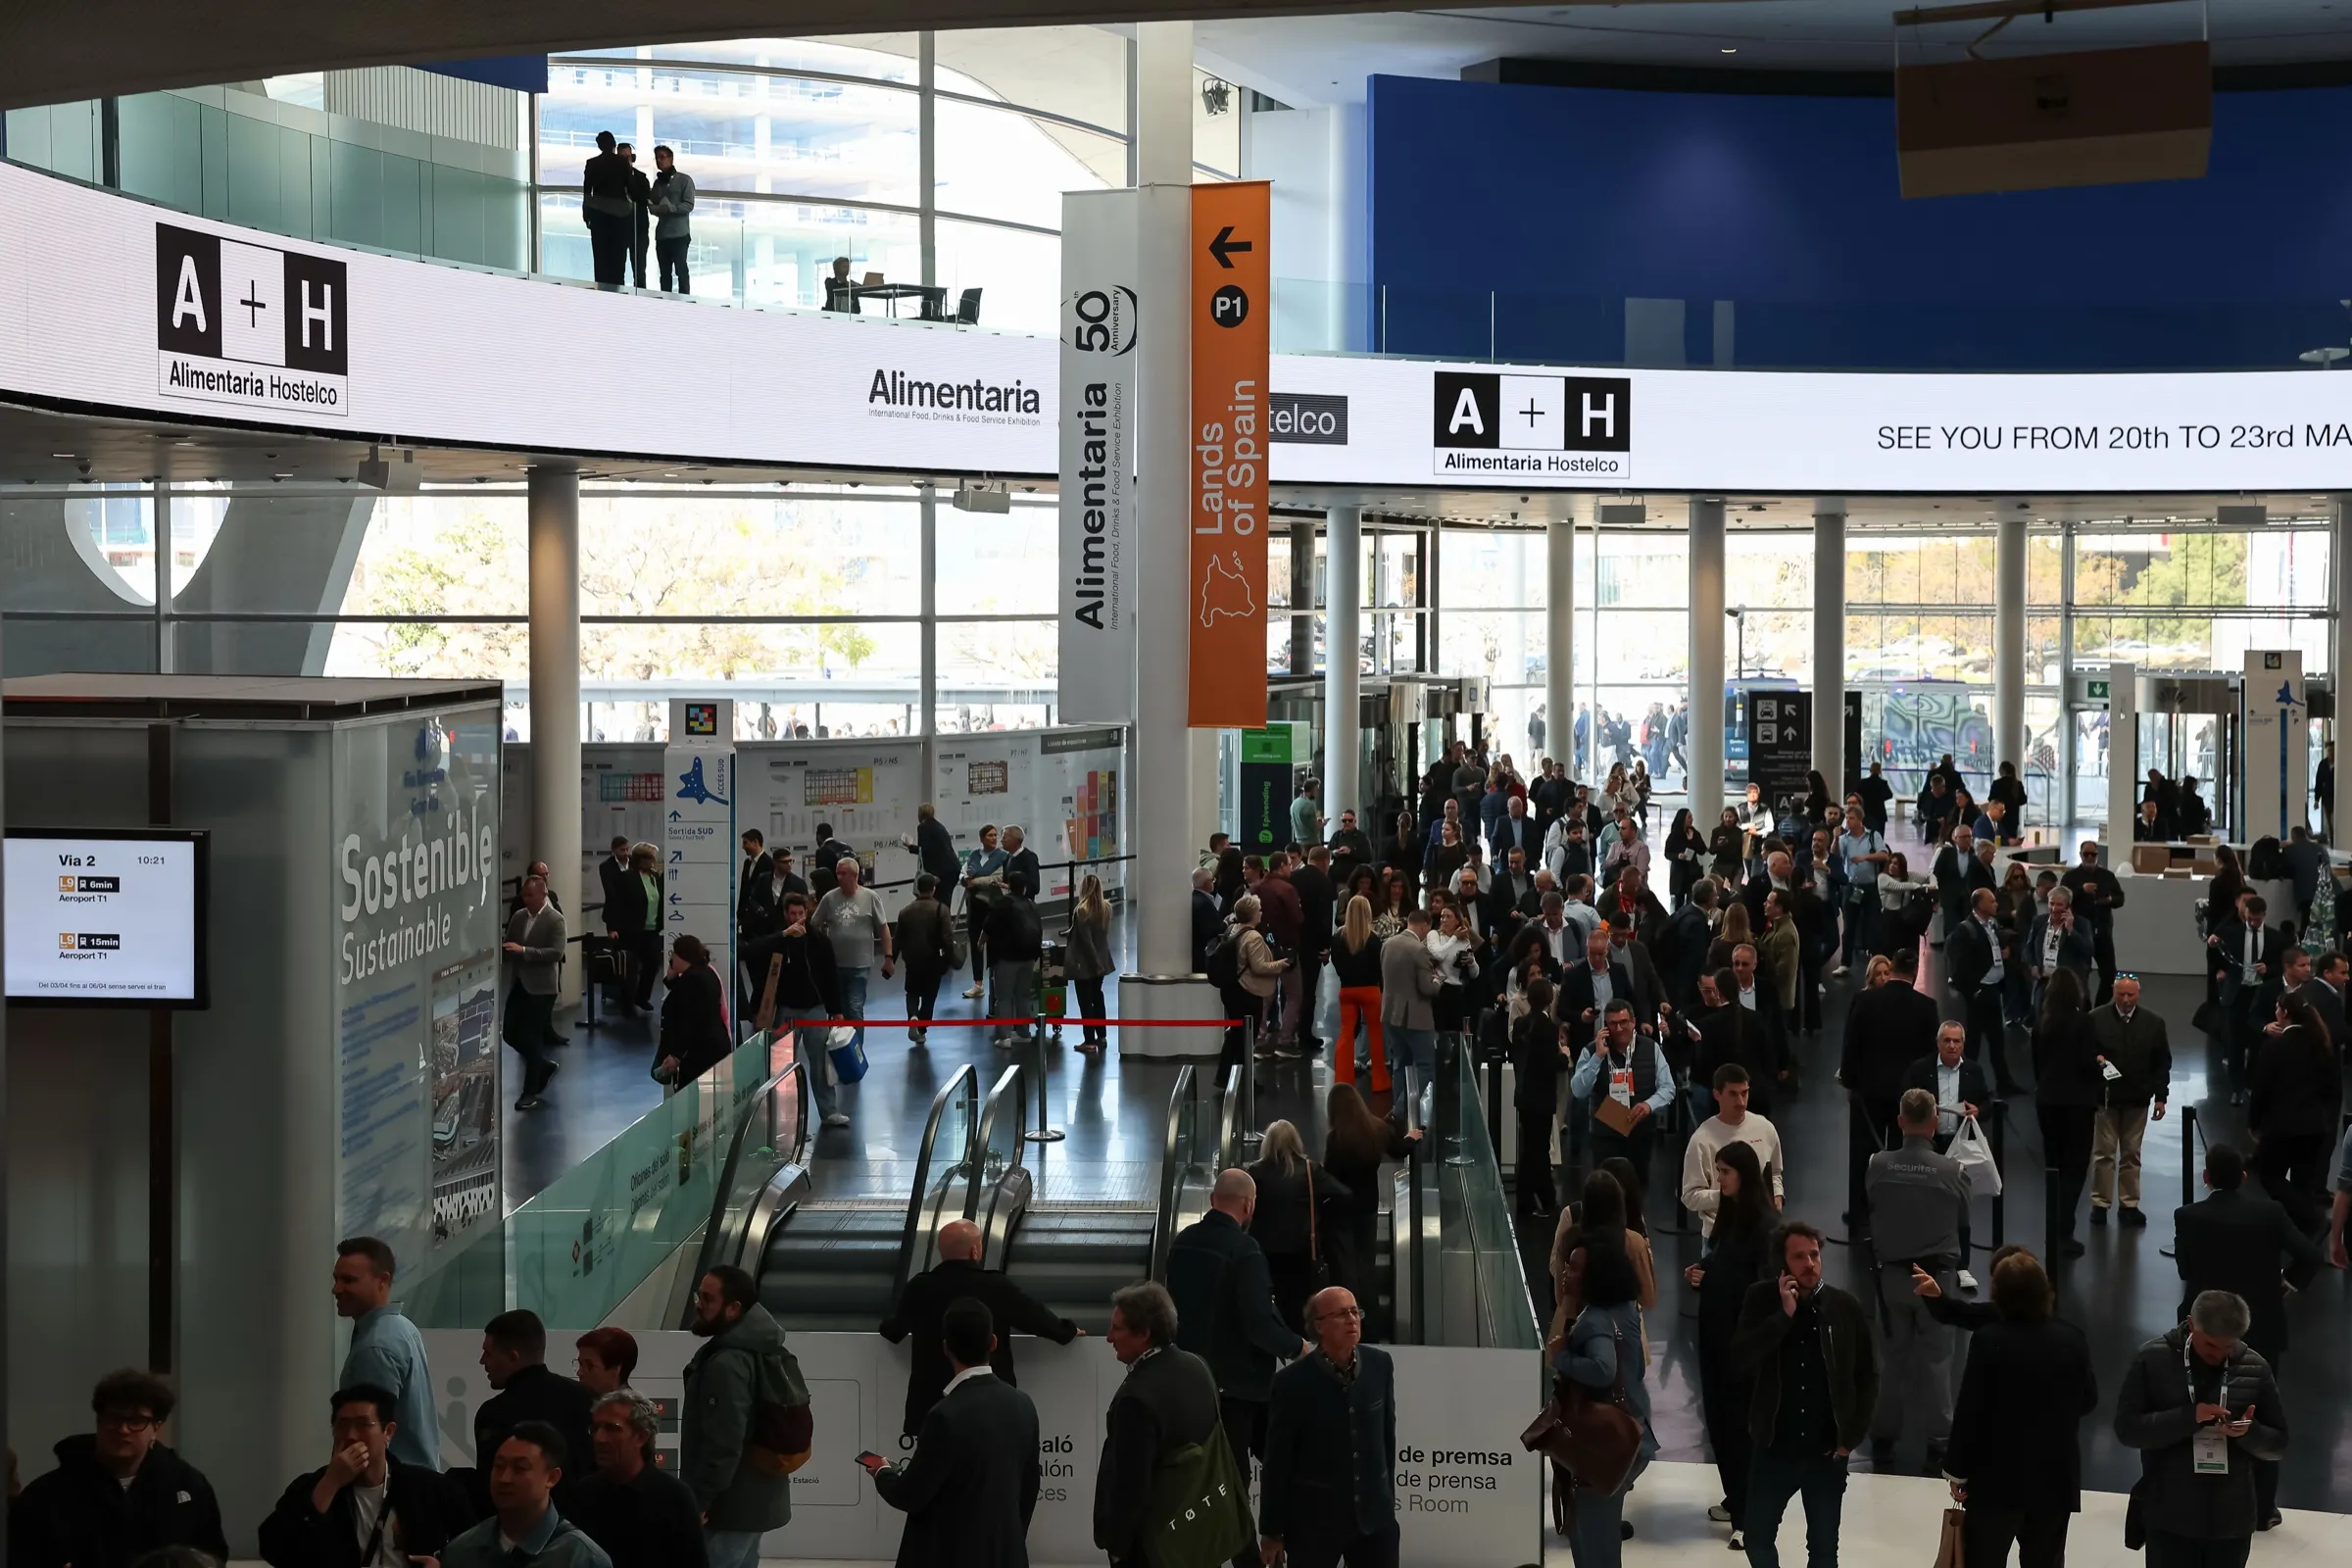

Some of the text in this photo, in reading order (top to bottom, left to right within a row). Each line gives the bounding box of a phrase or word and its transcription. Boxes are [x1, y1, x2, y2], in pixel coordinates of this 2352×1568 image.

[172, 255, 207, 333] A
[302, 279, 332, 351] H
[1216, 297, 1242, 318] P1
[1111, 289, 1121, 351] Anniversary
[170, 361, 337, 406] Alimentaria Hostelco
[868, 368, 1040, 415] Alimentaria
[868, 408, 1041, 426] International Food, Drinks & Food Service Exhibition
[1112, 382, 1122, 430] Exhibition
[1269, 403, 1336, 435] telco
[1448, 387, 1484, 435] A
[1582, 392, 1614, 438] H
[1112, 431, 1121, 468] Service
[1878, 425, 1932, 450] SEE
[1940, 425, 2002, 450] YOU
[2013, 425, 2098, 450] FROM
[2108, 425, 2169, 450] 20th
[2179, 424, 2221, 450] TO
[2230, 424, 2294, 449] 23rd
[1227, 380, 1262, 535] of Spain
[1445, 453, 1618, 472] Alimentaria Hostelco
[1196, 422, 1224, 534] Lands
[1075, 382, 1107, 630] Alimentaria
[1111, 505, 1120, 538] Drinks
[1111, 539, 1121, 568] Food,
[1110, 570, 1120, 630] International
[668, 827, 713, 836] Sortida SUD
[59, 855, 96, 866] Via 2
[137, 856, 165, 864] 10:21
[342, 806, 492, 922] Sostenible
[60, 878, 113, 889] L9 6min
[59, 894, 96, 904] Aeroport
[59, 952, 96, 960] Aeroport
[60, 935, 119, 947] L9 15min
[342, 903, 451, 985] Sustainable
[1886, 1161, 1937, 1174] Securitas
[1398, 1446, 1512, 1468] de premsa
[1396, 1470, 1496, 1492] de prensa
[1169, 1484, 1227, 1531] TØTE
[1409, 1494, 1469, 1513] Room
